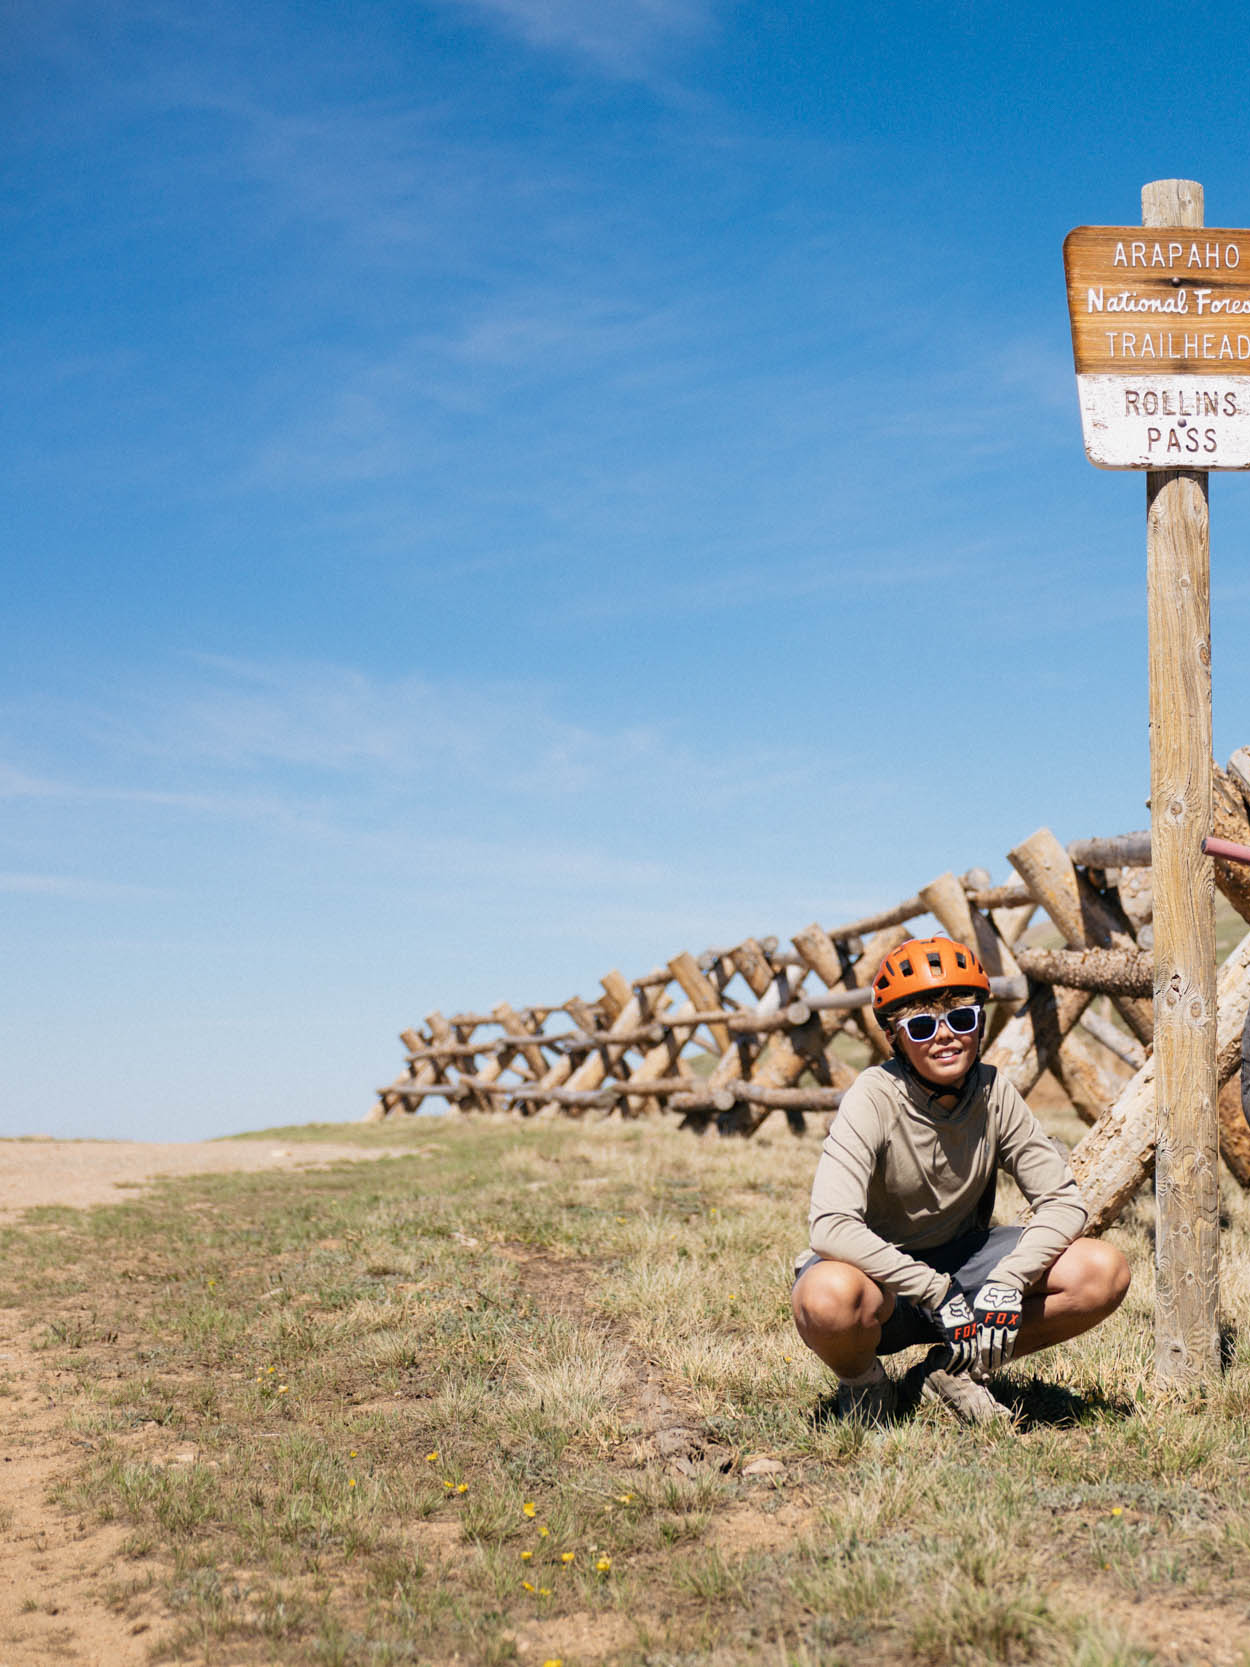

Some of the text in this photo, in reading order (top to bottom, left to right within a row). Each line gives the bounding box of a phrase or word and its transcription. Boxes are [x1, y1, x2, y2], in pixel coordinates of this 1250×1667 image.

[1113, 242, 1240, 269] ARAPAHO
[1087, 287, 1189, 314] National
[1125, 390, 1238, 417] ROLLINS
[1147, 427, 1219, 453] PASS
[985, 1312, 1019, 1325] FOX
